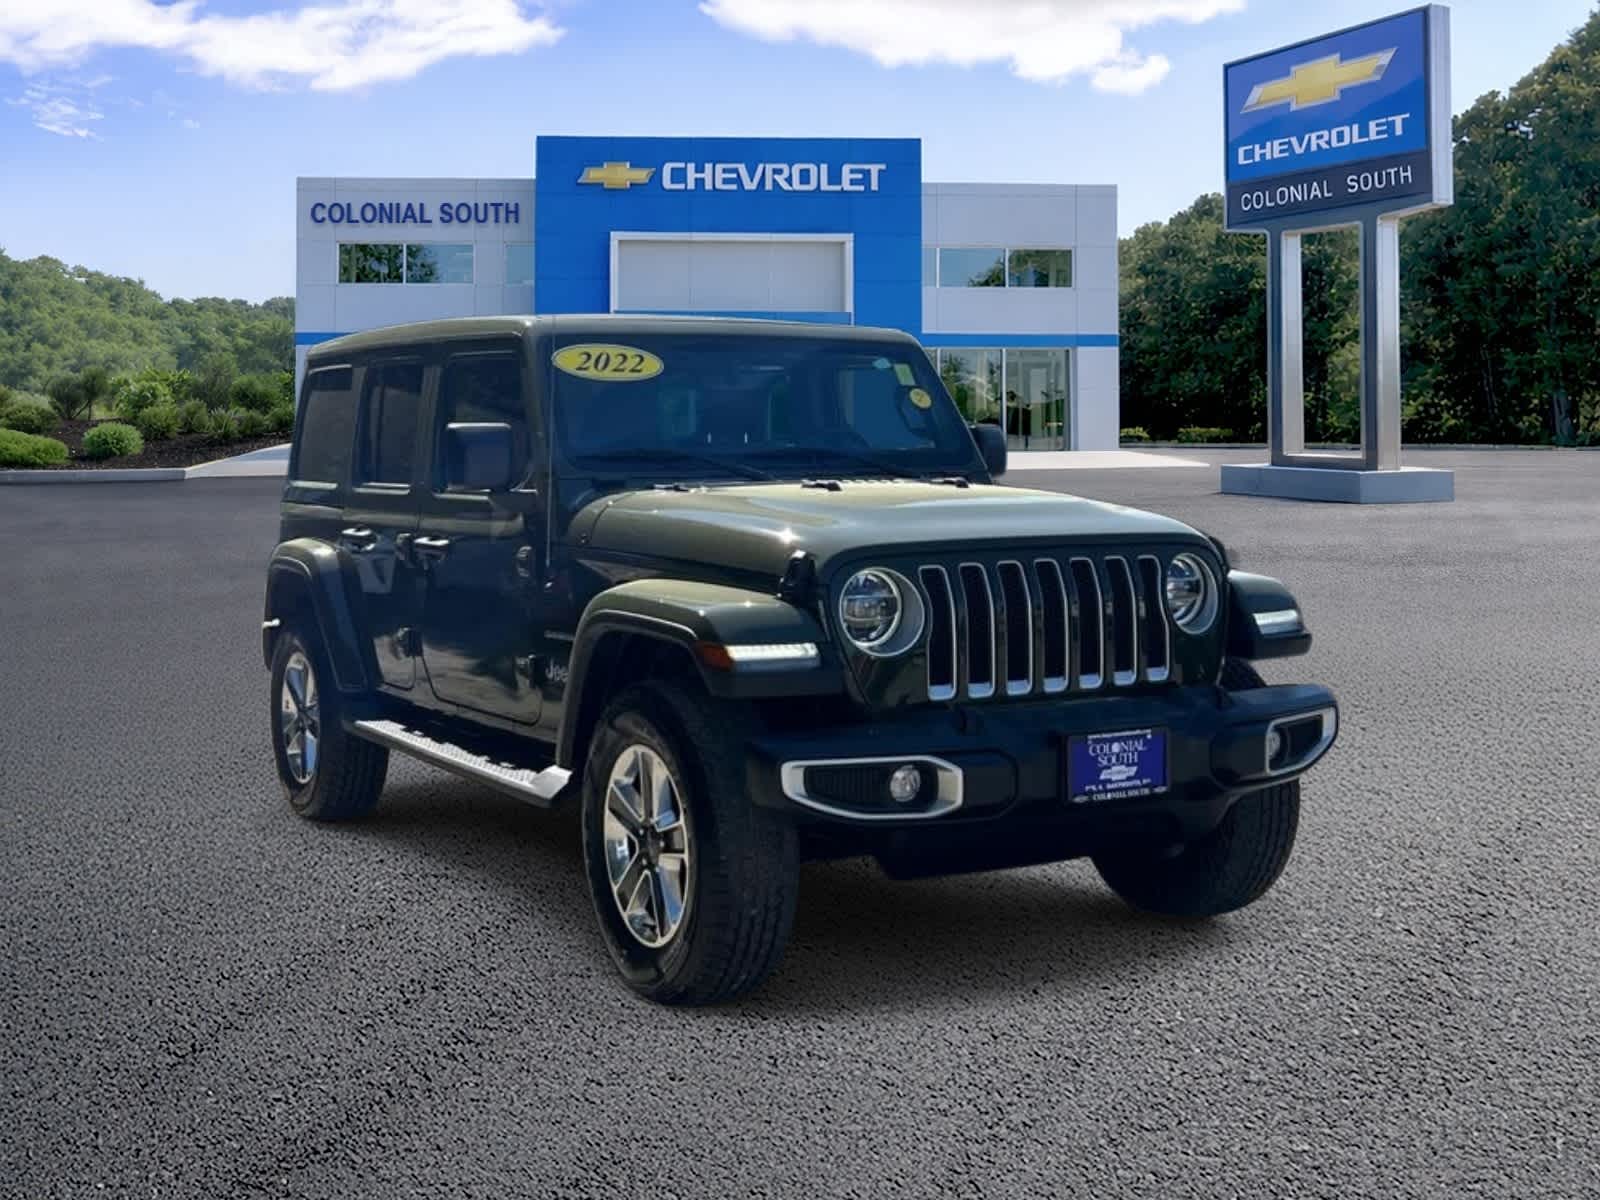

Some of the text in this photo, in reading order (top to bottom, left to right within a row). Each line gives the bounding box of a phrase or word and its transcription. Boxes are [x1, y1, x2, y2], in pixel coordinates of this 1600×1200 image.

[1237, 113, 1411, 166] CHEVROLET
[661, 161, 887, 192] CHEVROLET
[1240, 165, 1413, 211] COLONIAL SOUTH
[310, 202, 520, 224] COLONIAL SOUTH
[575, 350, 645, 373] 2022
[1088, 738, 1148, 757] COLONIAL
[1097, 751, 1139, 768] SOUTH
